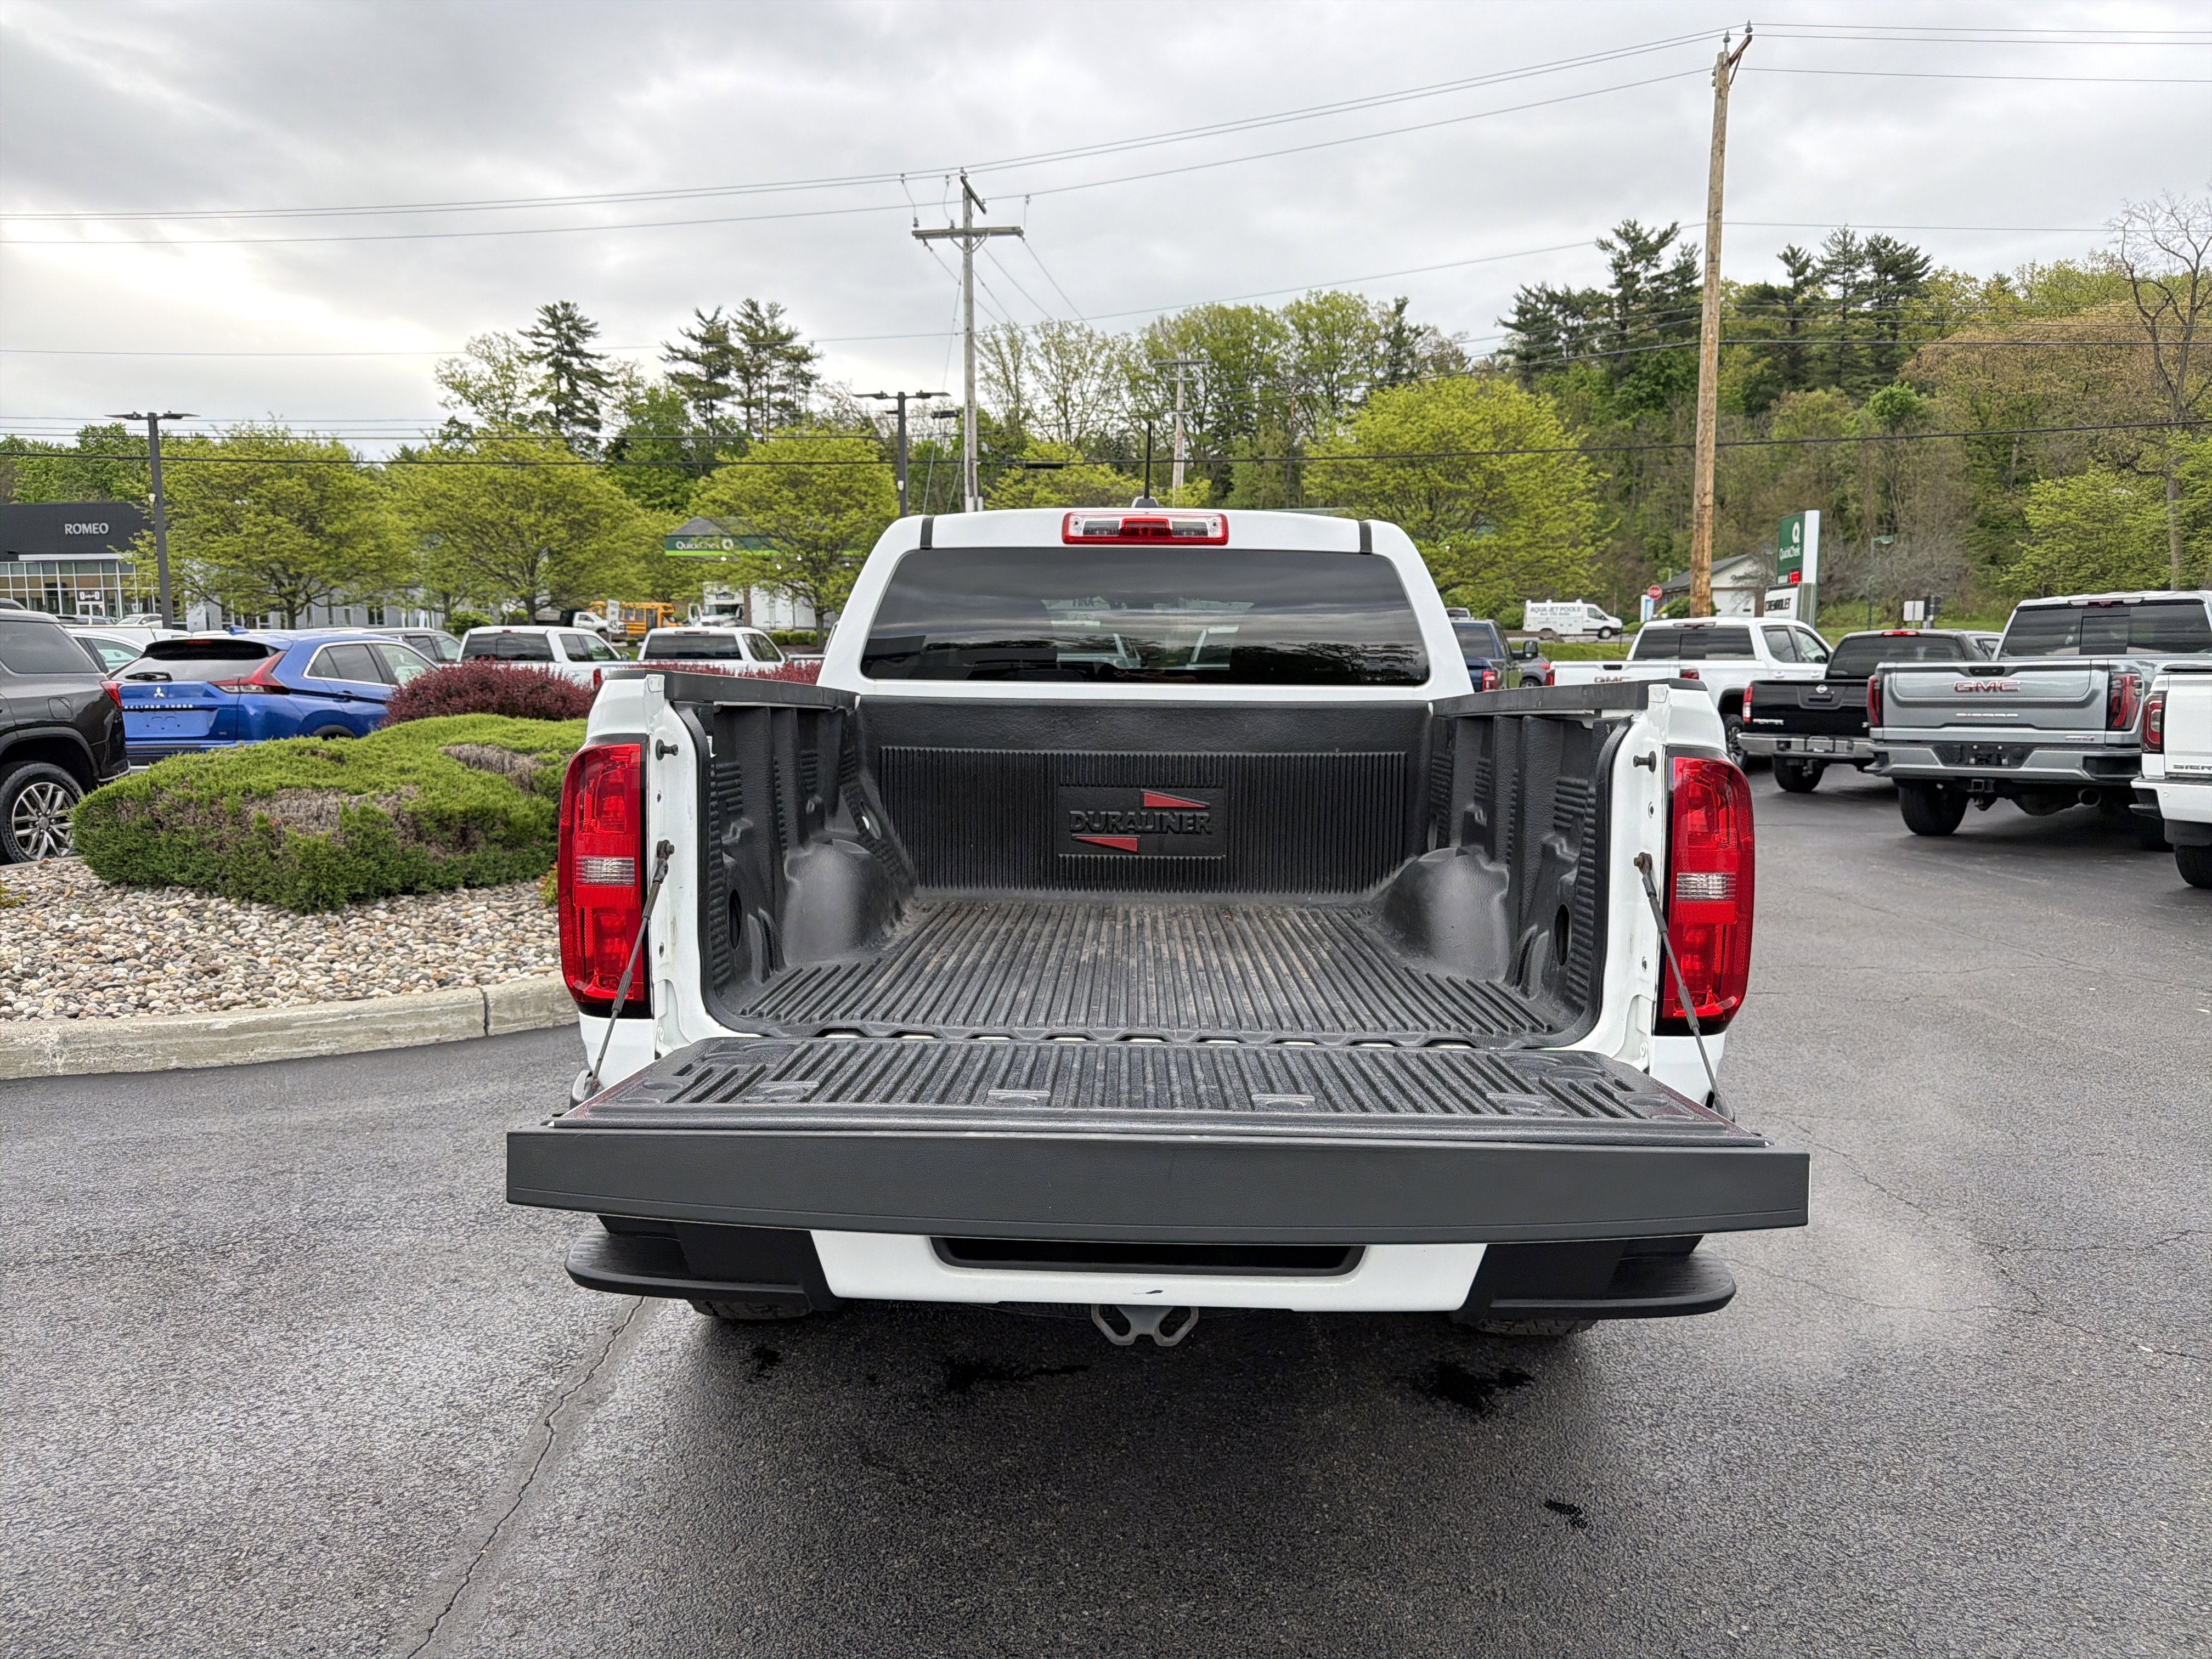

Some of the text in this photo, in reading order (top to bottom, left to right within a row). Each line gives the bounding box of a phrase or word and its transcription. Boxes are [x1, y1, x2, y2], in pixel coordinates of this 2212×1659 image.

[64, 522, 109, 535] ROMEO
[1954, 680, 2021, 693] GMC
[1069, 810, 1211, 834] DURALINER
